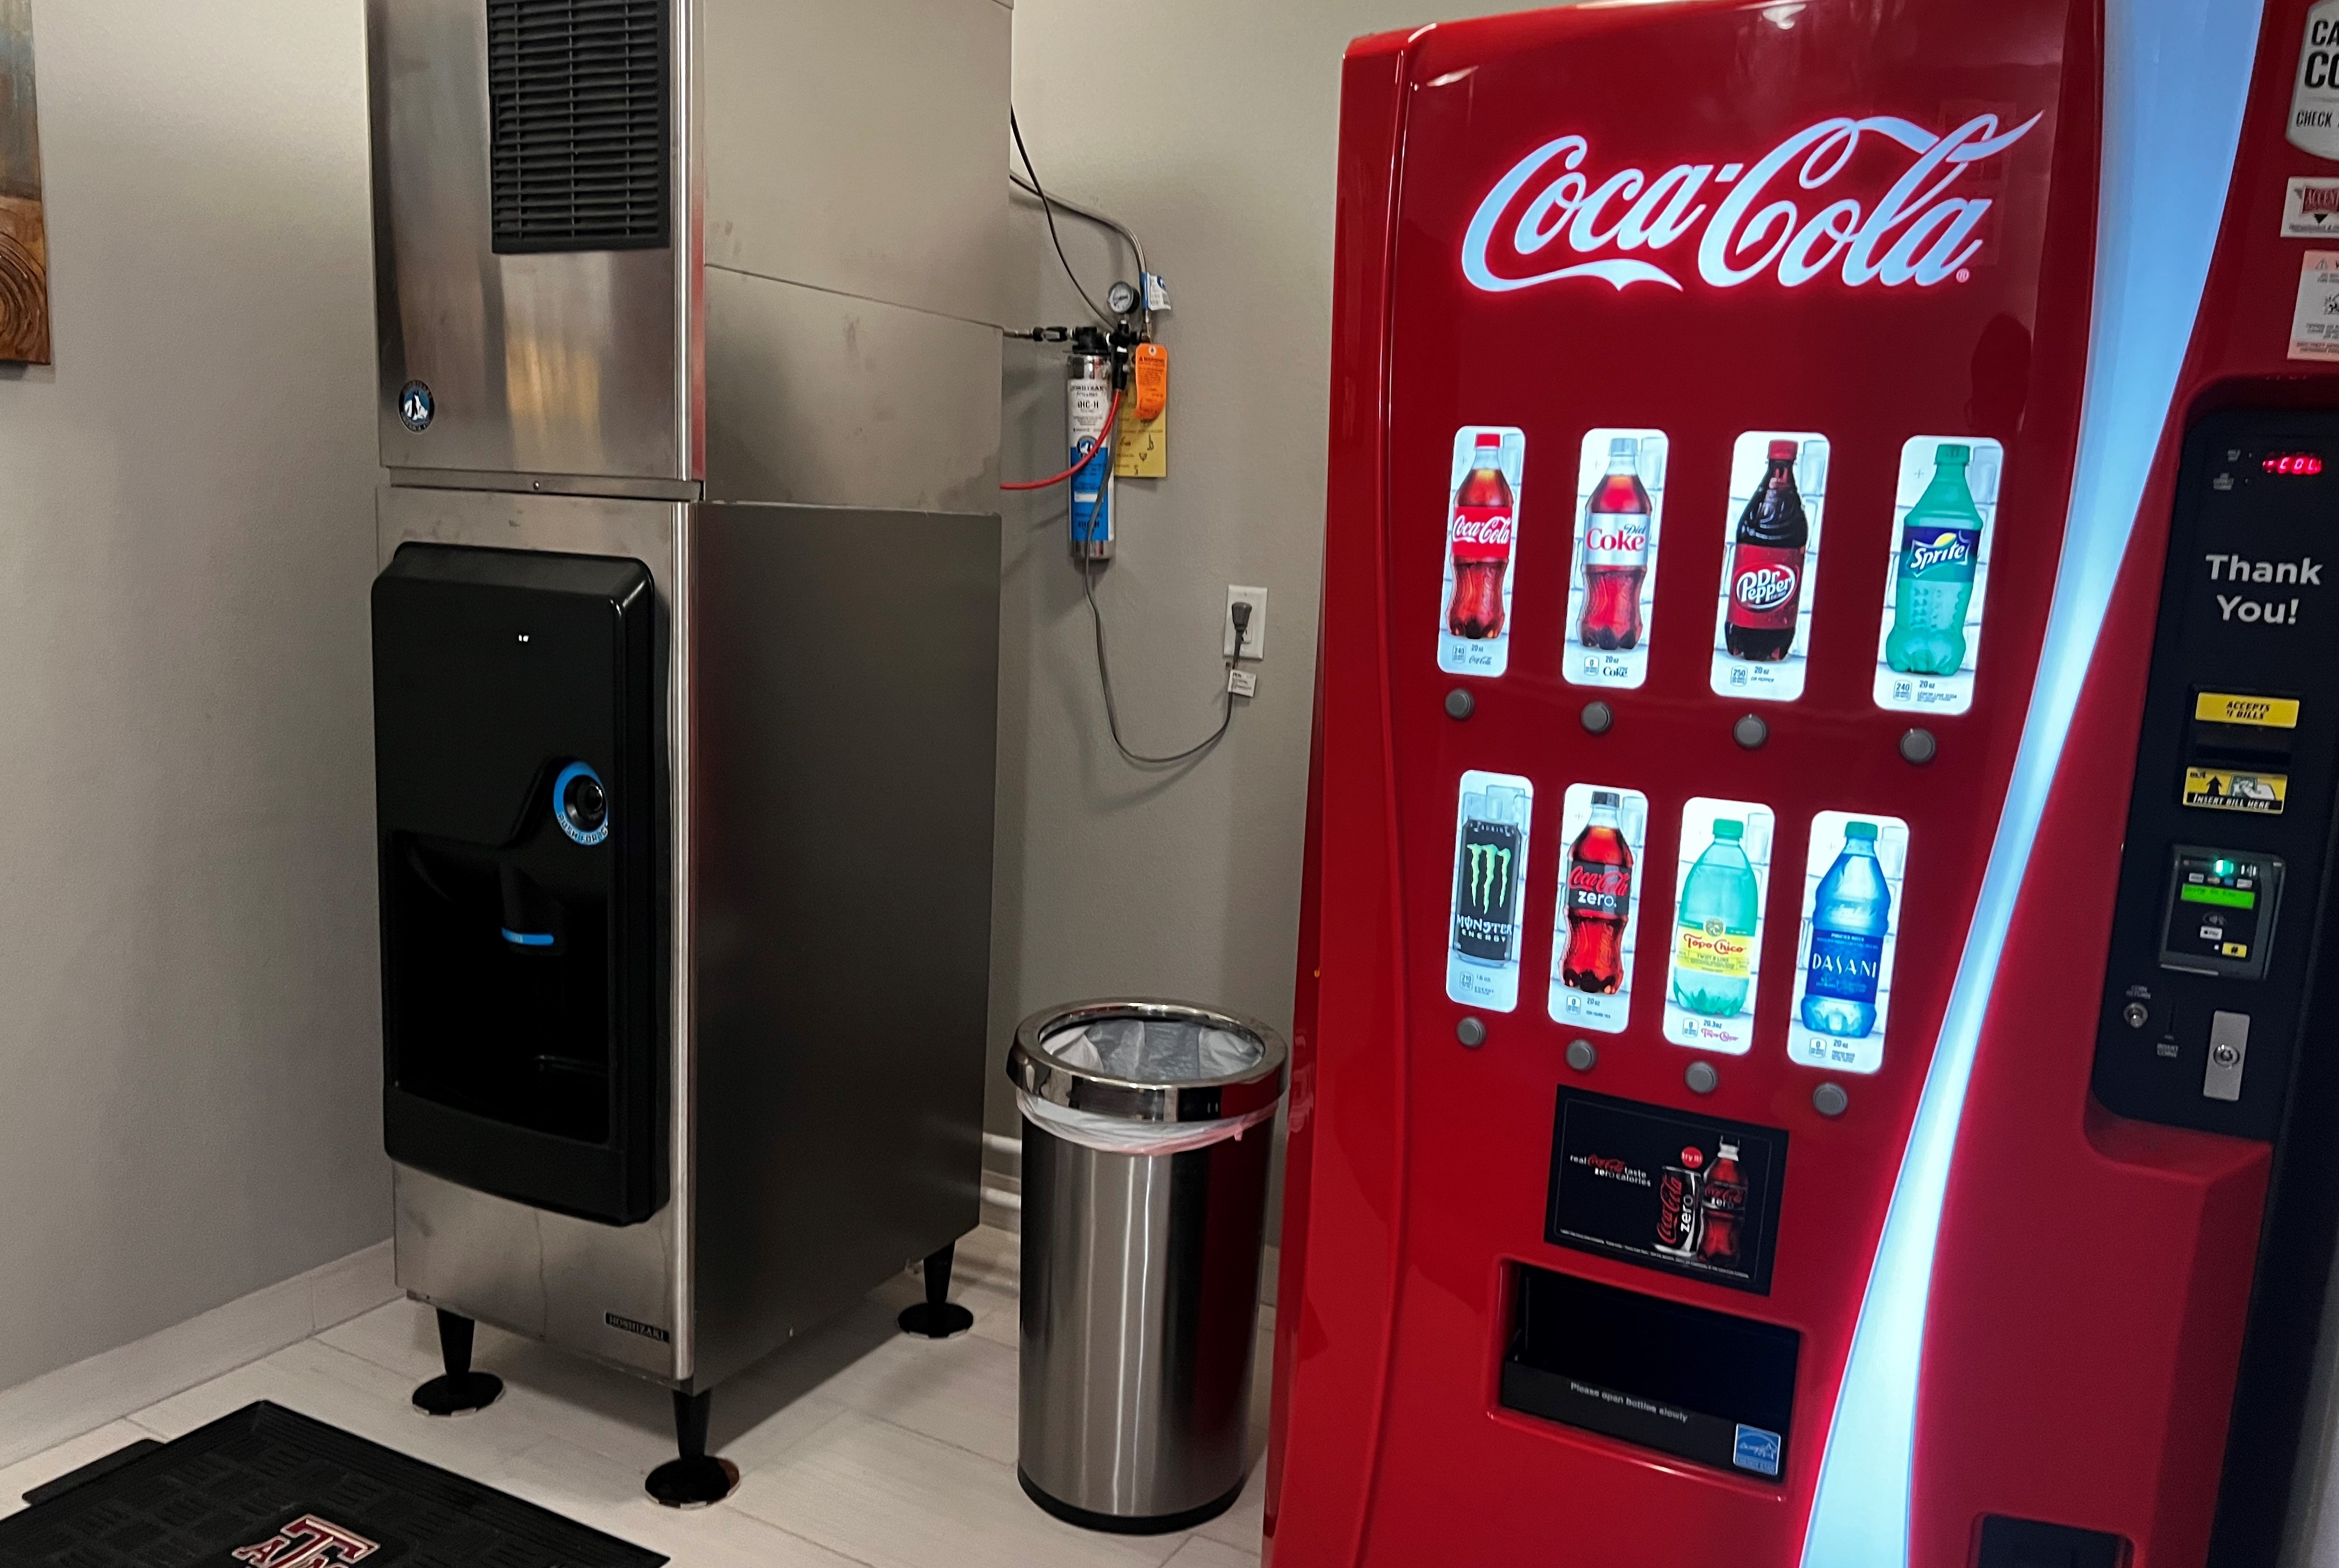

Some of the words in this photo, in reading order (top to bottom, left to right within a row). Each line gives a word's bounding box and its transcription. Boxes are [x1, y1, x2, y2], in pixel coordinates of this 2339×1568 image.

[2296, 110, 2333, 128] CHECK
[1462, 109, 2043, 291] Coca-Cola
[1452, 514, 1511, 545] Coca-Cola
[1586, 527, 1645, 552] Coke
[1910, 540, 1965, 570] Sprite
[2205, 553, 2323, 585] Thank
[1737, 571, 1792, 604] Pepper
[1757, 568, 1780, 587] Dr
[2217, 594, 2300, 625] You!
[2193, 793, 2223, 805] INSERT
[1569, 866, 1631, 897] Coca-Cola
[1456, 914, 1512, 935] MONSTER
[1683, 933, 1712, 949] Topo
[1714, 939, 1747, 954] Chico
[1812, 953, 1877, 979] DASANI
[1570, 1154, 1587, 1166] real
[1624, 1166, 1647, 1179] taste
[1595, 1167, 1615, 1178] zero
[1615, 1172, 1651, 1188] calories
[1680, 1194, 1693, 1233] zero
[1570, 1381, 1600, 1397] Please
[1601, 1392, 1624, 1404] open
[1626, 1397, 1657, 1413] bottles
[1658, 1407, 1688, 1423] slowly
